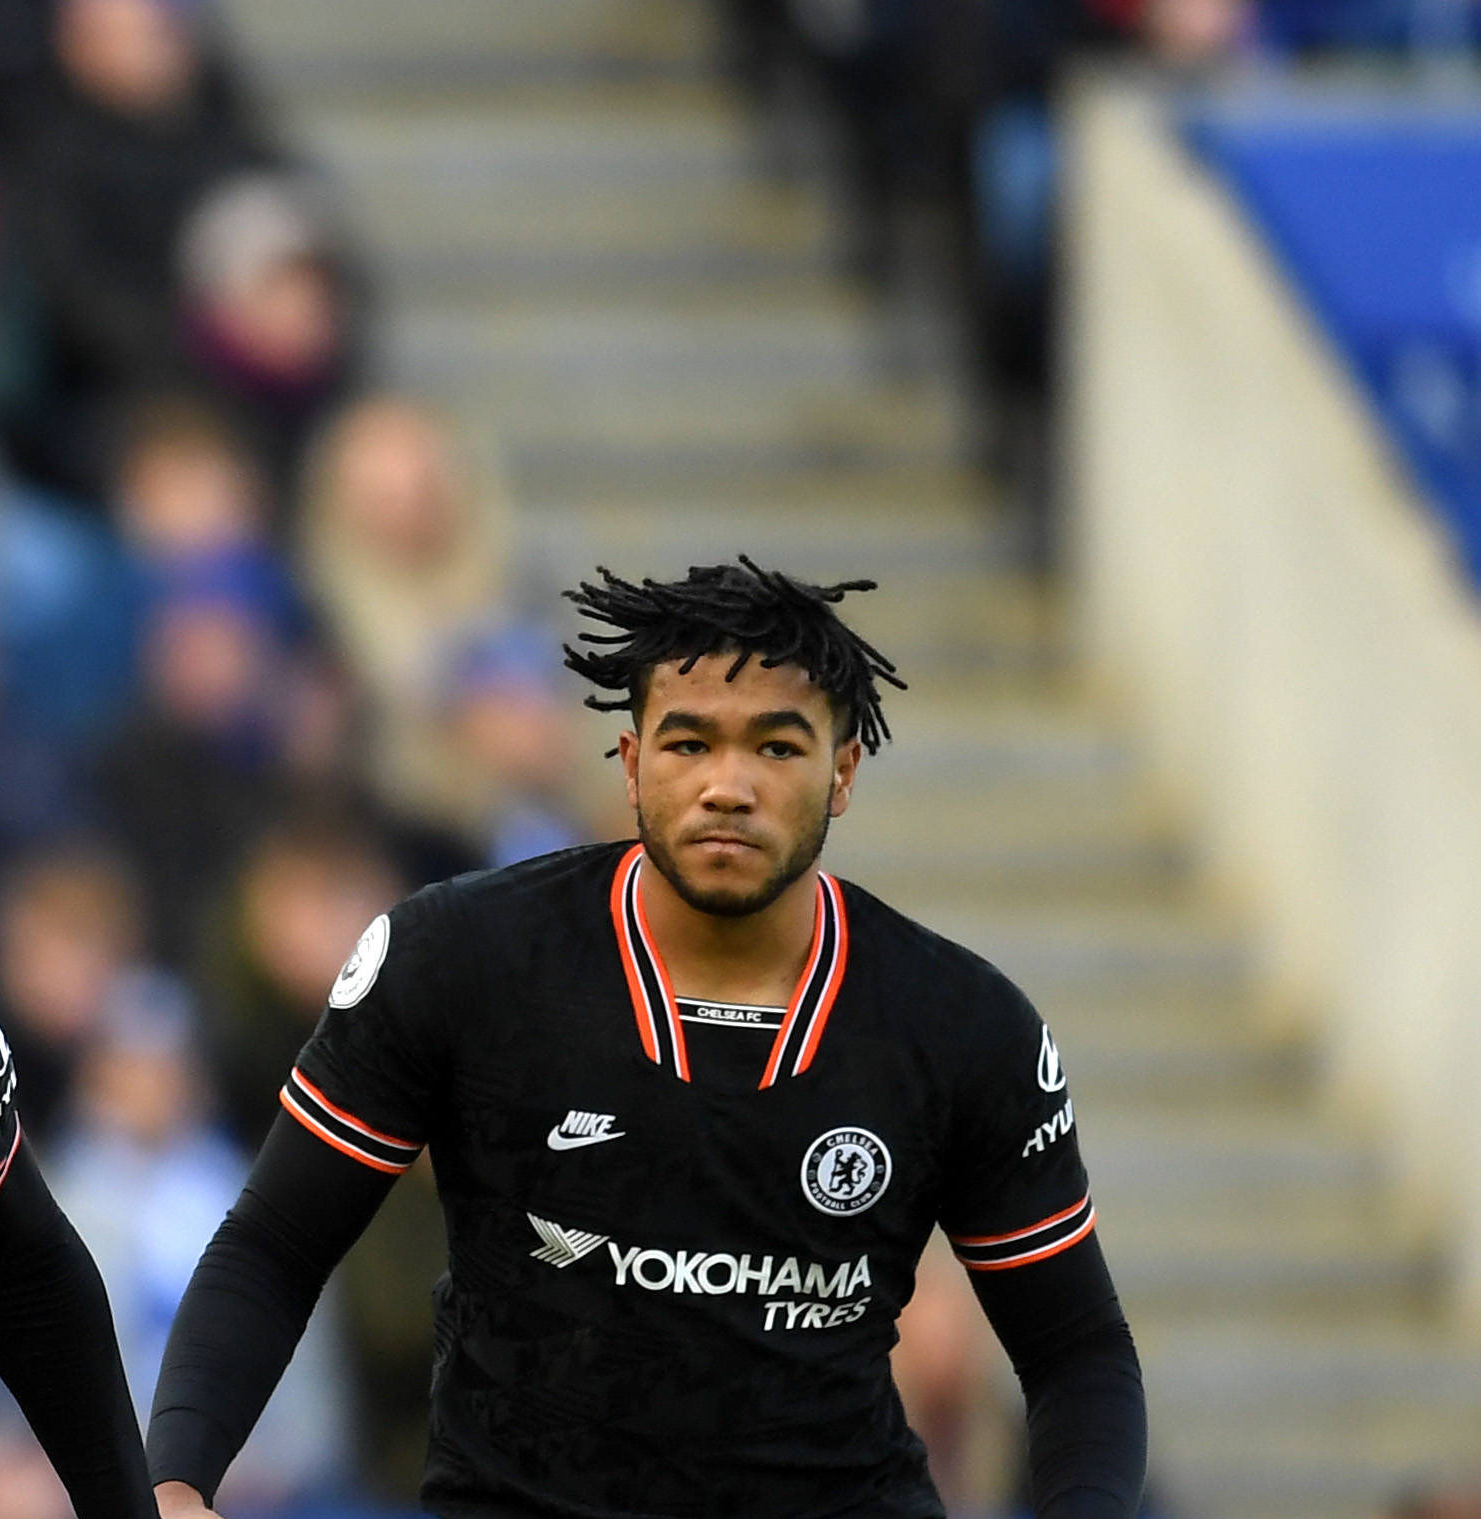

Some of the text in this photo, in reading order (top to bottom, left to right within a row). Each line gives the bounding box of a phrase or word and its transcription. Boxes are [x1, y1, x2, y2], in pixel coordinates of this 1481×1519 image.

[697, 1007, 762, 1022] CHELSEA FC
[559, 1109, 616, 1137] NIKE
[826, 1133, 879, 1157] CHELSEA
[607, 1240, 873, 1299] YOKOHAMA
[762, 1296, 873, 1332] TYRES
